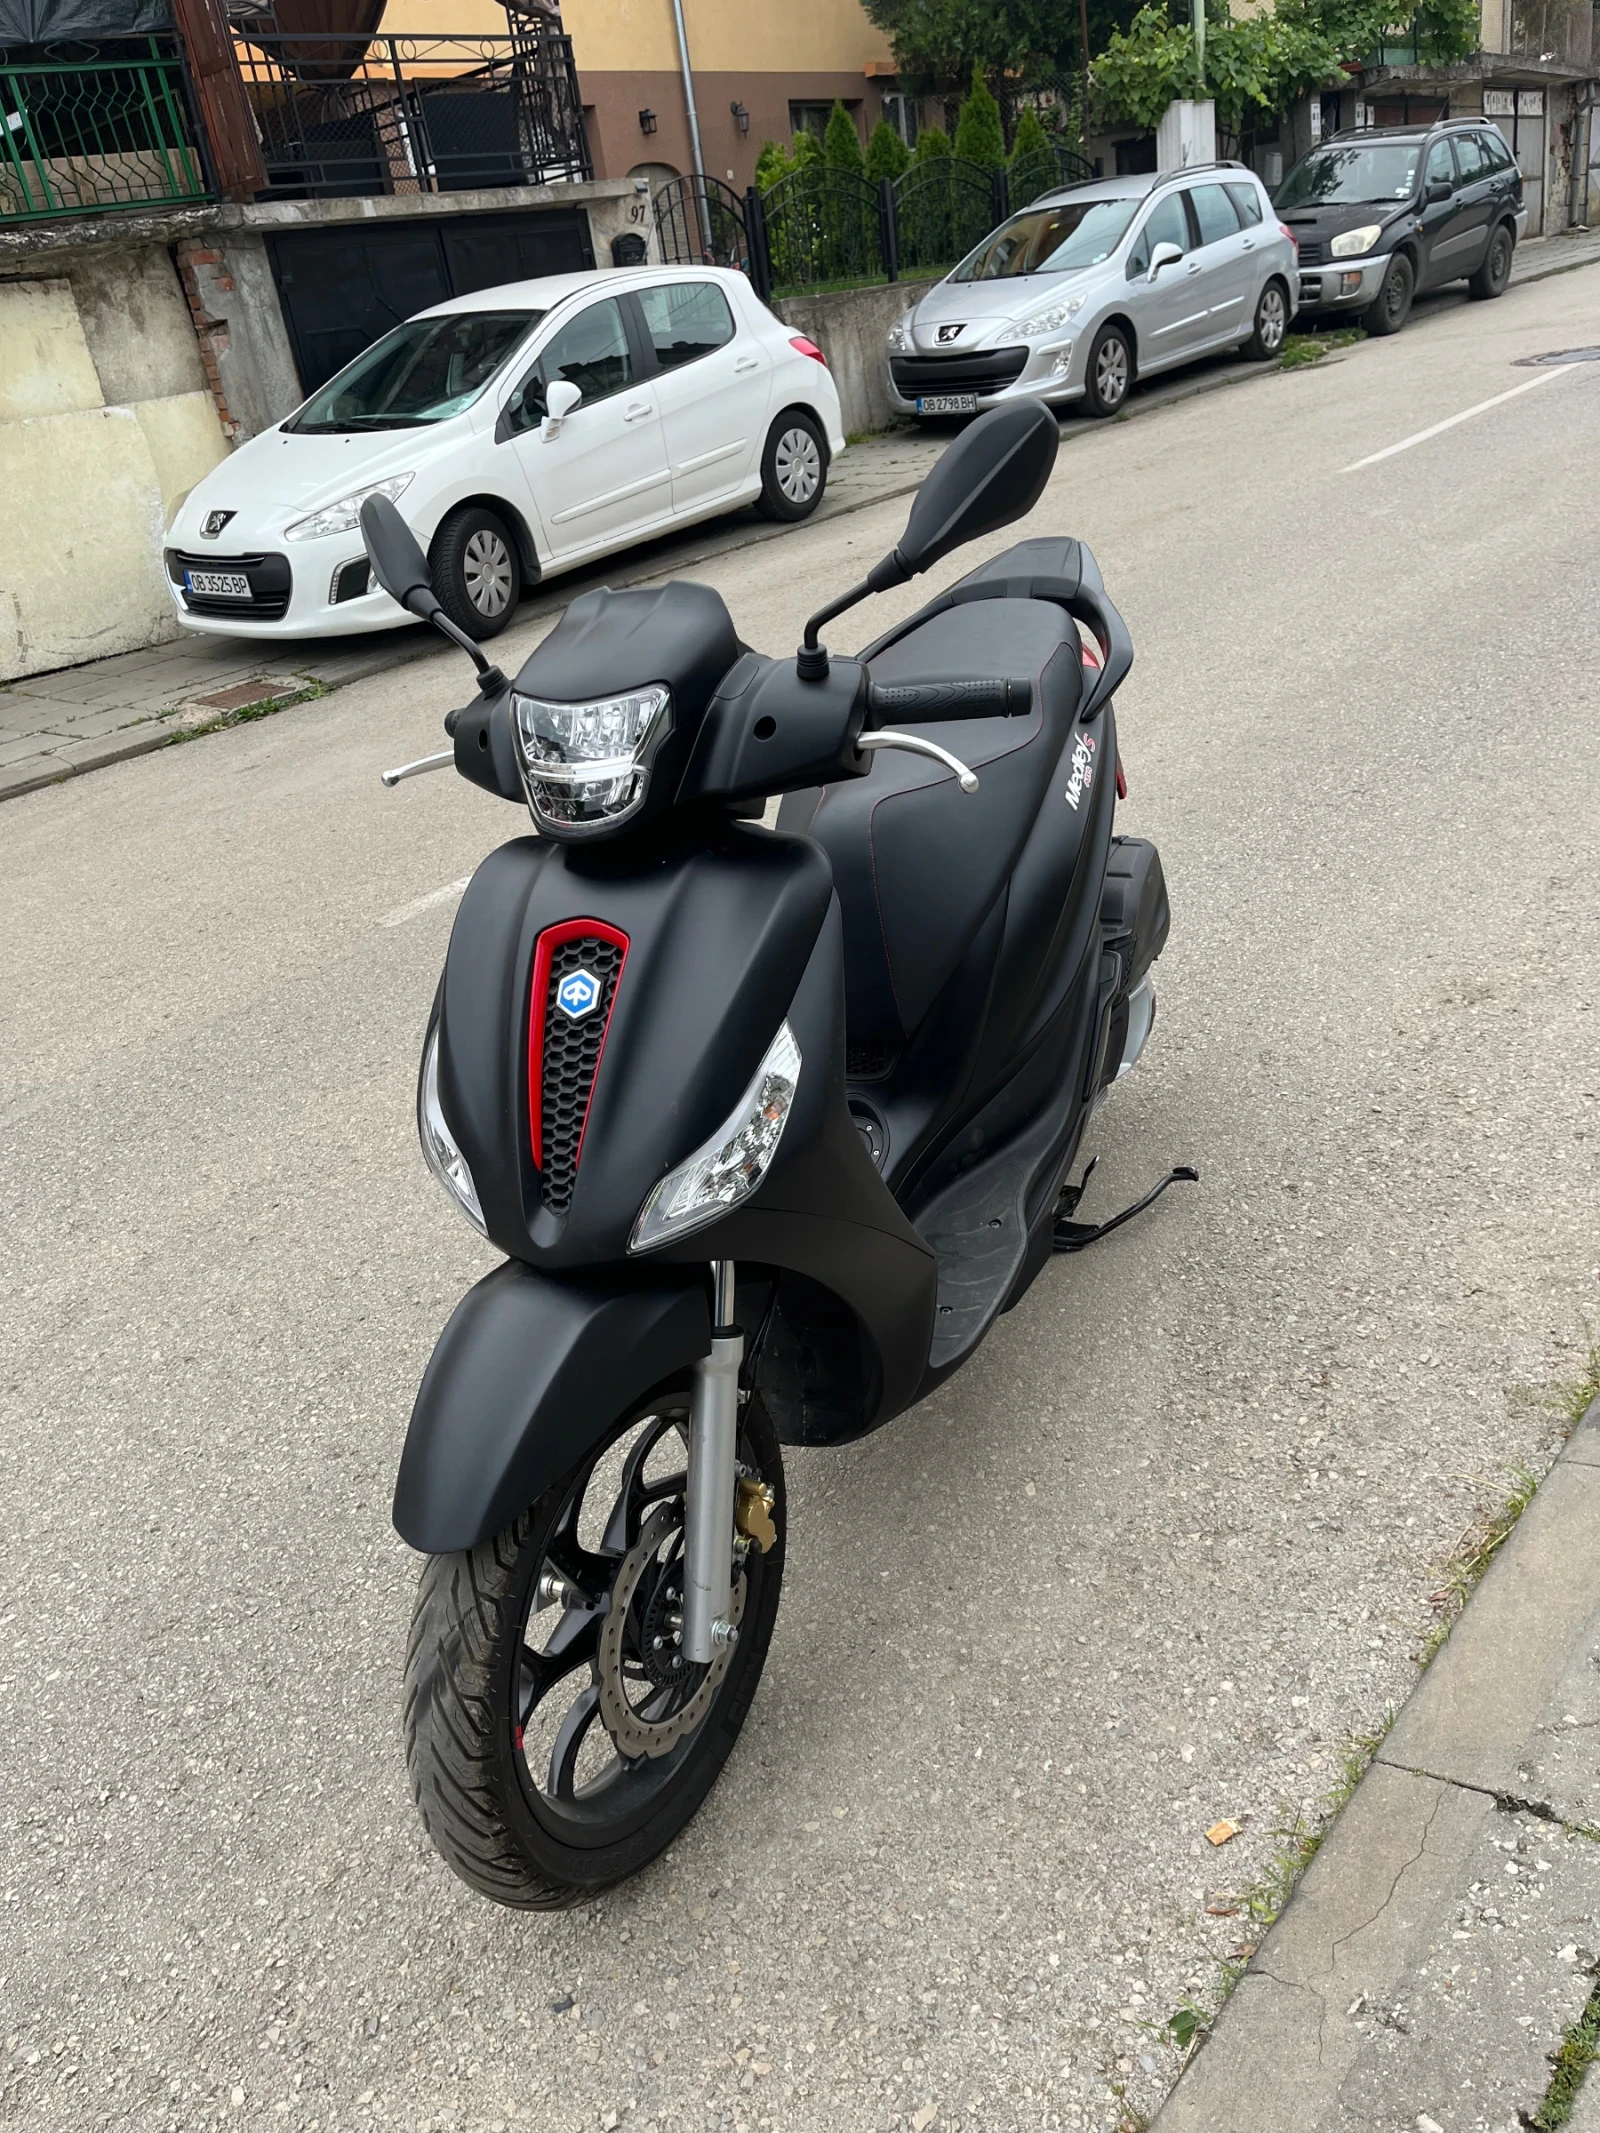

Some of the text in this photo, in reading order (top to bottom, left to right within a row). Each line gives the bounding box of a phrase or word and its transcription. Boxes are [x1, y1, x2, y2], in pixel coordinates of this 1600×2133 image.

[631, 204, 646, 224] 97
[923, 396, 975, 411] OB 2798 BH
[191, 574, 206, 591] OB
[205, 575, 233, 593] 3525
[231, 577, 247, 594] BP
[1064, 731, 1096, 811] Medley S
